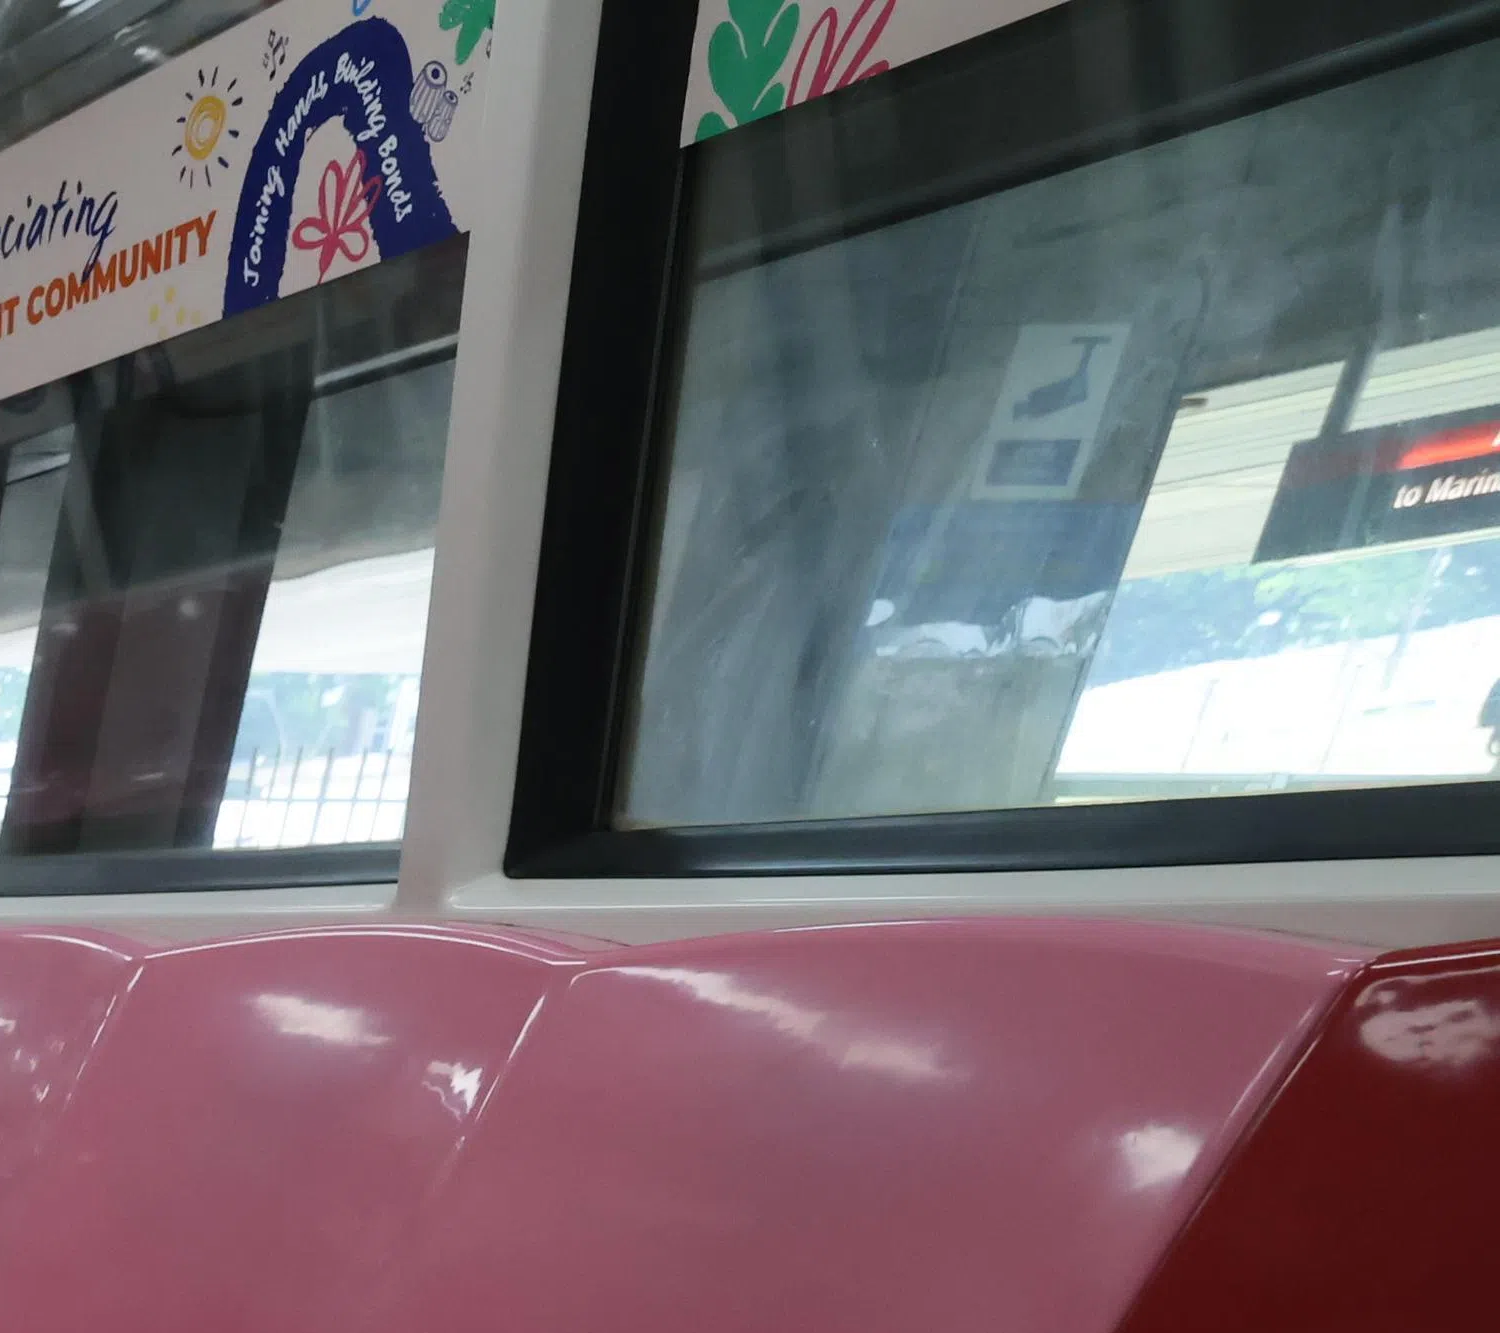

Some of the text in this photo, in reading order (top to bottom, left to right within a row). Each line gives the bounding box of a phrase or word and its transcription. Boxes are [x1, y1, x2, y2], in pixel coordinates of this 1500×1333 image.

[243, 165, 284, 287] Joining
[334, 52, 387, 142] Building
[378, 134, 413, 223] Bonds
[26, 209, 217, 326] COMMUNITY
[1393, 484, 1423, 509] to
